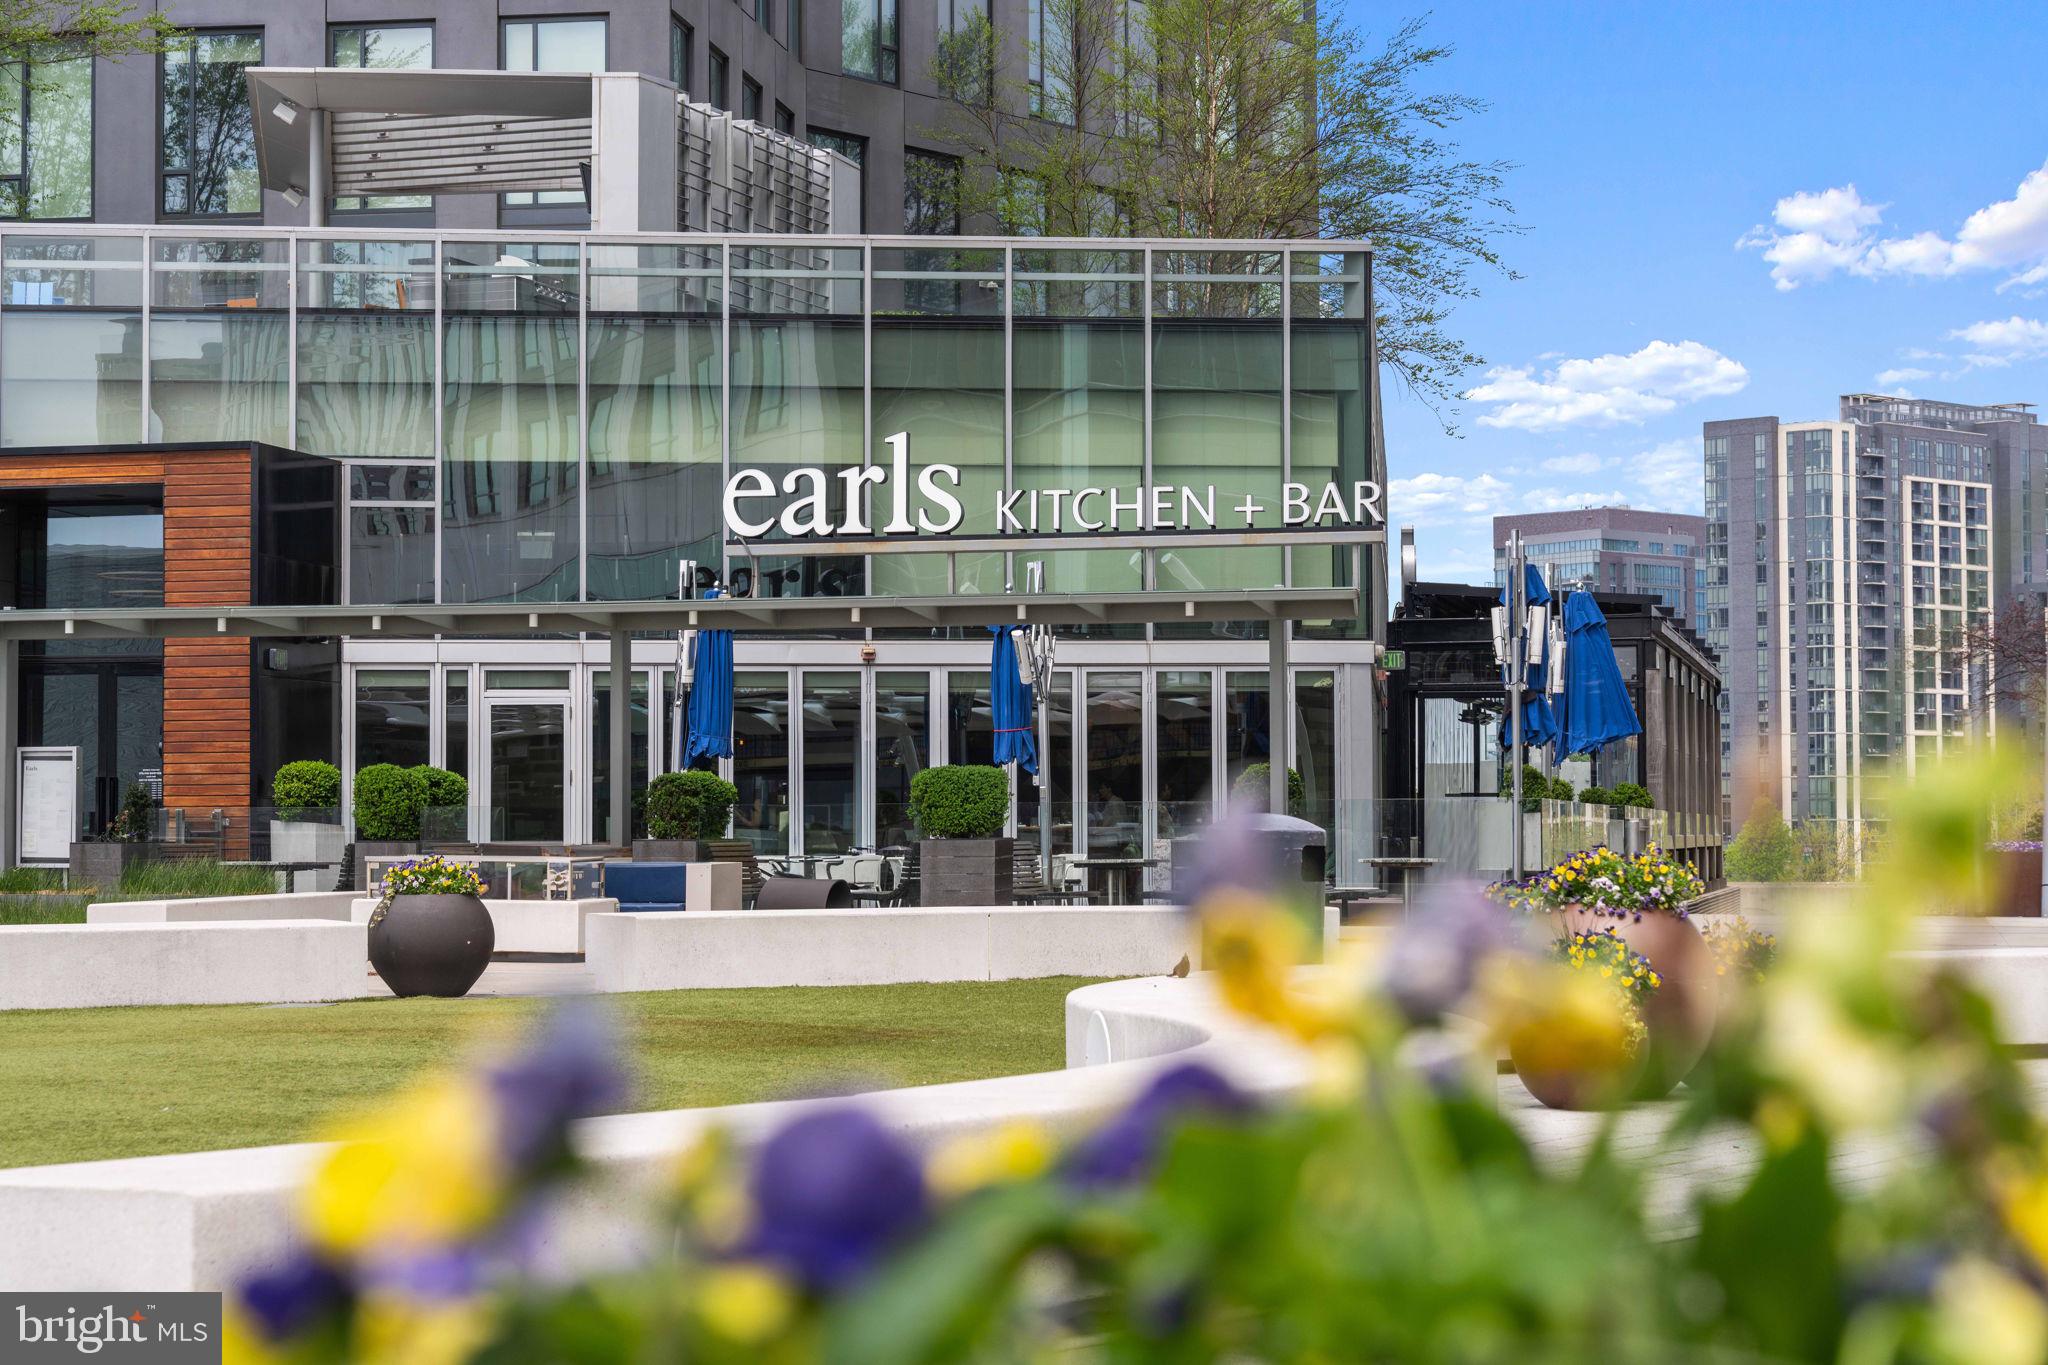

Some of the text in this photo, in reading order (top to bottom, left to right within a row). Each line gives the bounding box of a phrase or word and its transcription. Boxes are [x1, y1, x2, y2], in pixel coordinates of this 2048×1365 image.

[723, 431, 1385, 537] earls KITCHEN + BAR
[1383, 653, 1402, 668] EXIT
